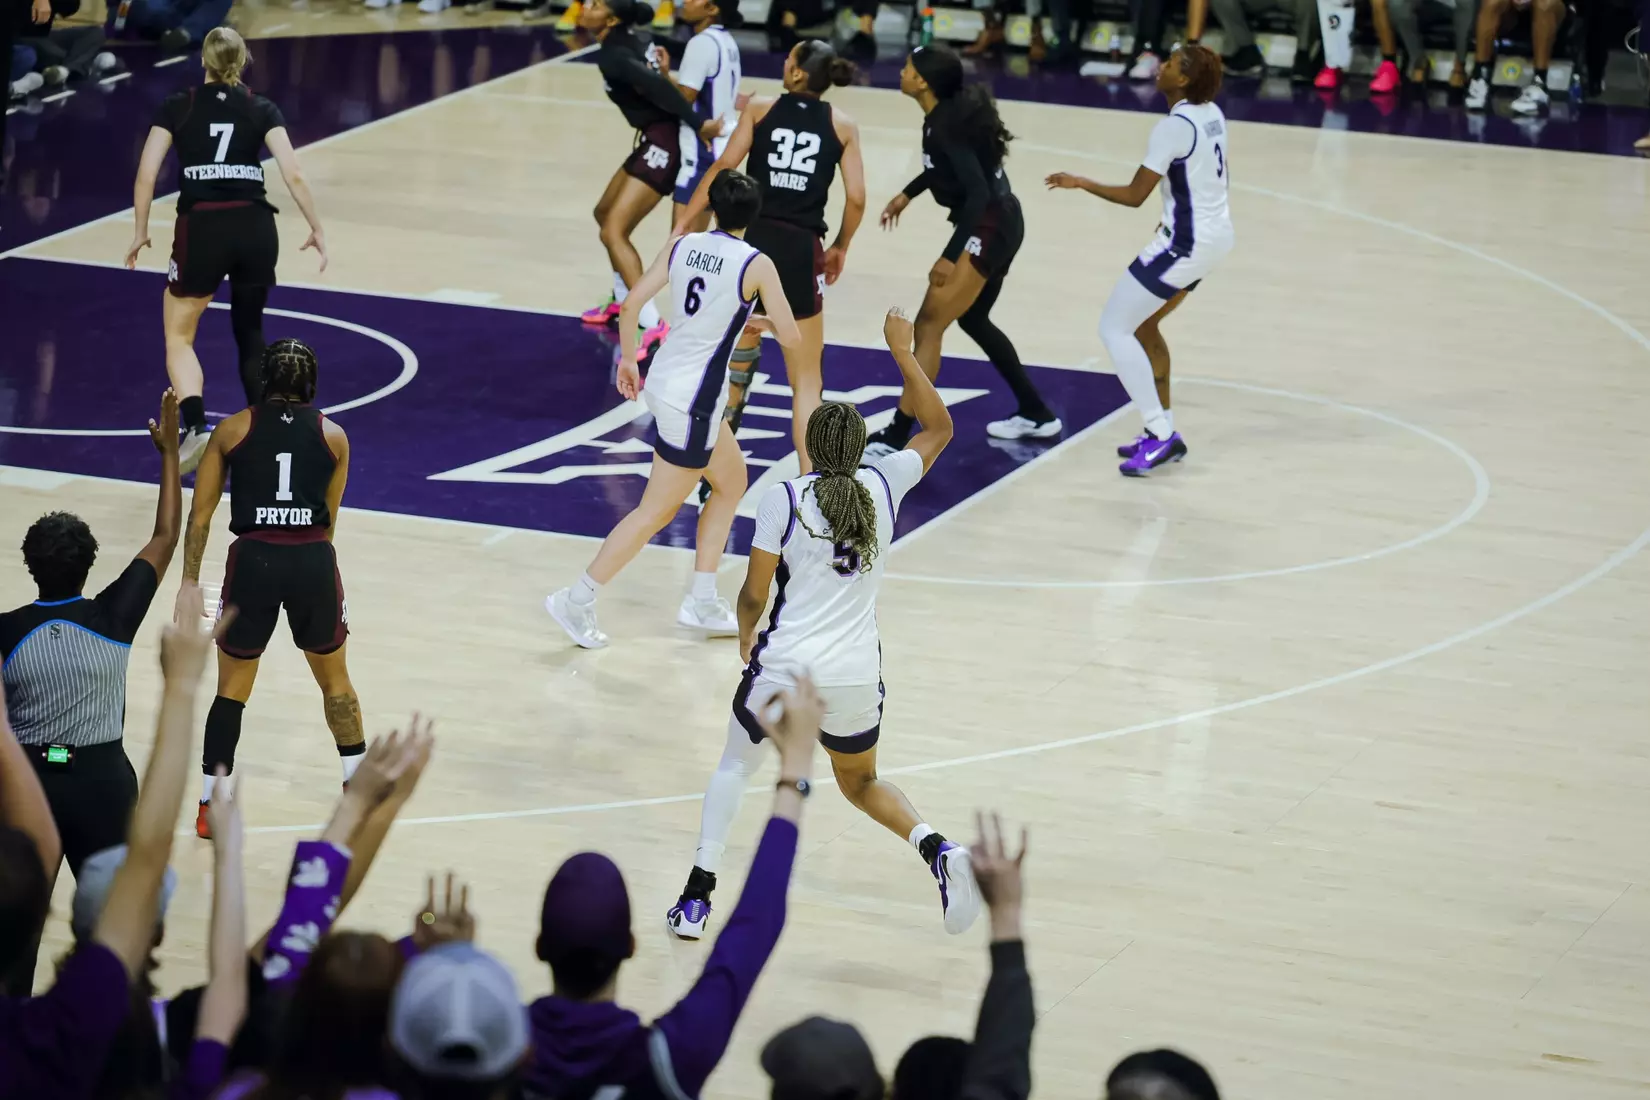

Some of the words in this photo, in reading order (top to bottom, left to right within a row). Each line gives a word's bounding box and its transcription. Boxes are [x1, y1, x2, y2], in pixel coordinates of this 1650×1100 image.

[209, 123, 234, 163] 7
[768, 128, 821, 174] 32
[770, 171, 808, 191] WARE
[686, 249, 724, 276] GARCIA
[684, 276, 706, 317] 6
[275, 452, 293, 501] 1
[255, 507, 313, 525] PRYOR
[832, 539, 862, 577] 5
